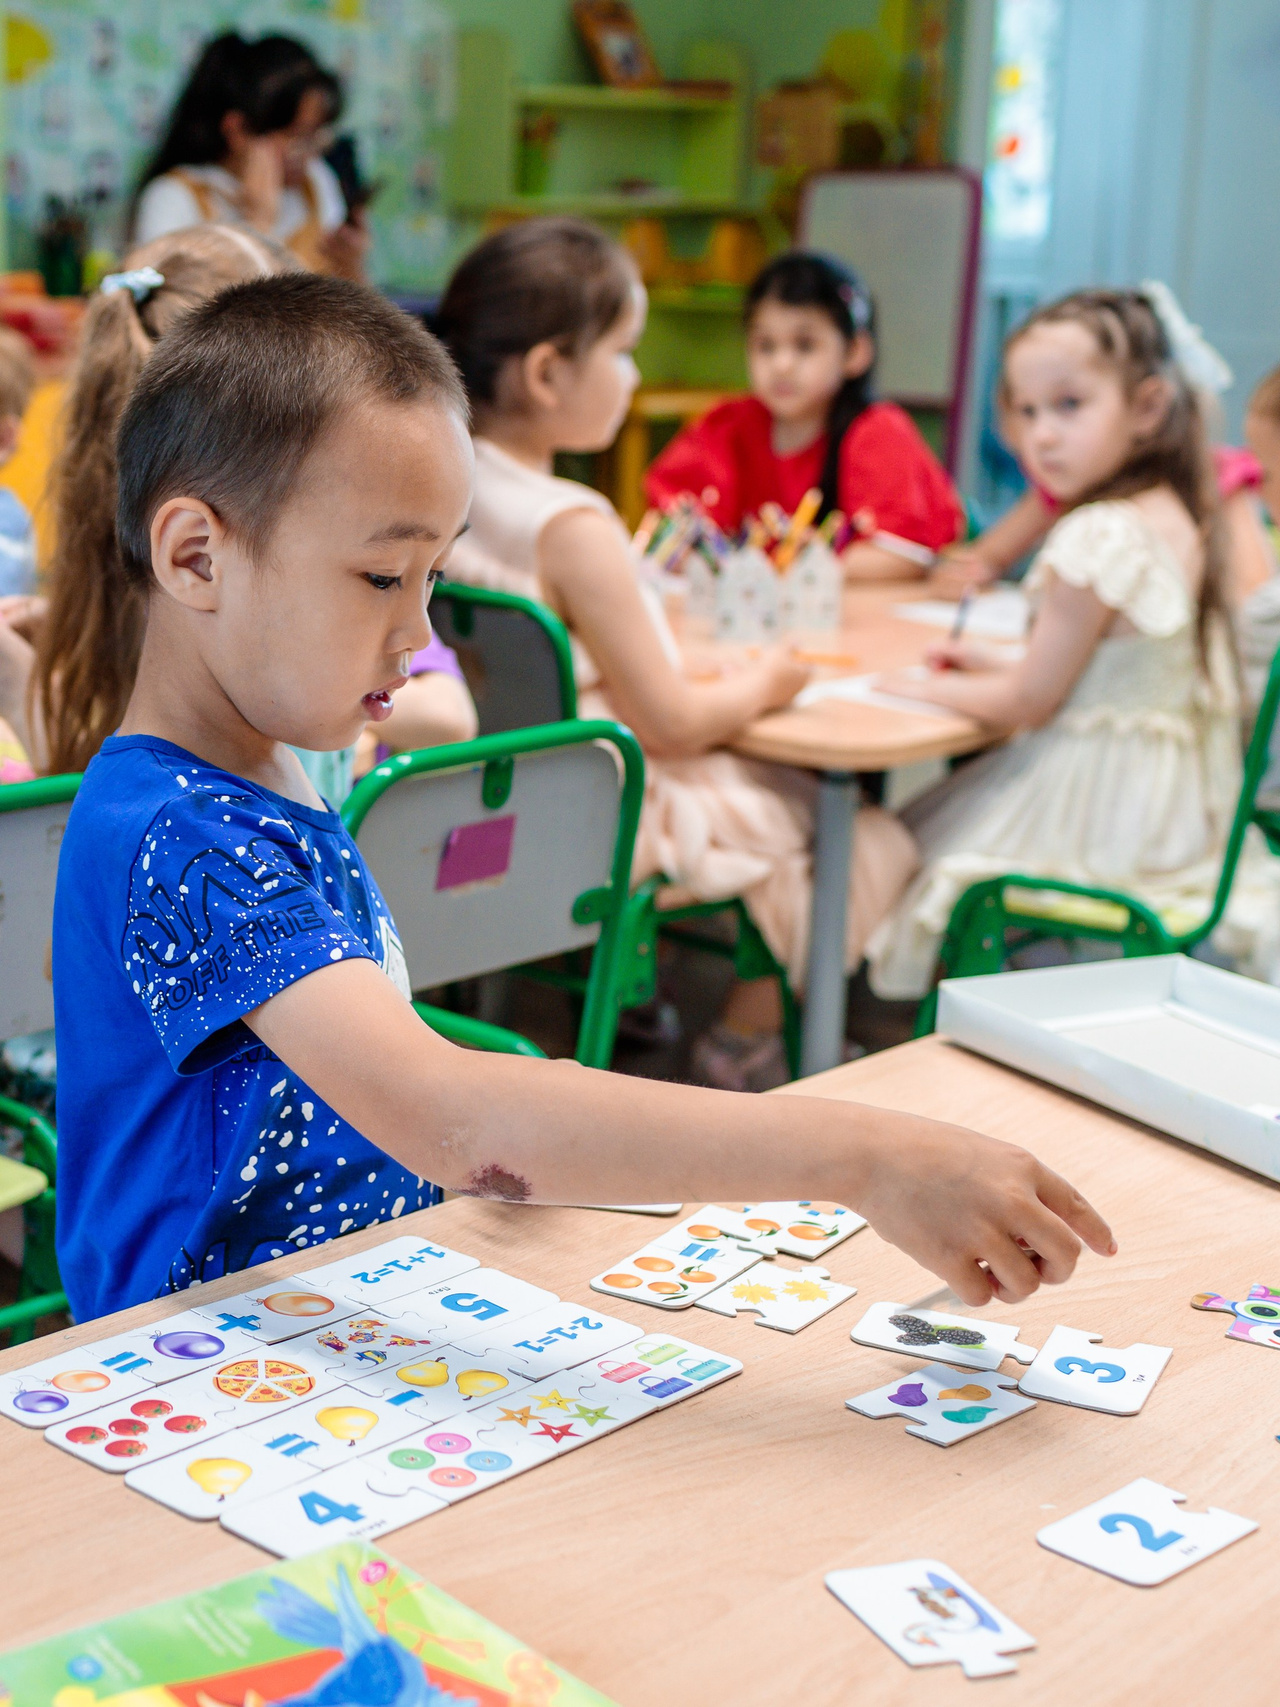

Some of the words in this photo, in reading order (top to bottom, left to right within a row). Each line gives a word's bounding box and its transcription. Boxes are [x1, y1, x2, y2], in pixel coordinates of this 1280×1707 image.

[231, 901, 327, 960] THE
[350, 1245, 447, 1285] 1+1=2
[439, 1291, 510, 1322] 5
[512, 1315, 605, 1354] 2-1=1
[1053, 1355, 1128, 1385] 3
[298, 1490, 366, 1527] 4
[1098, 1512, 1185, 1553] 2
